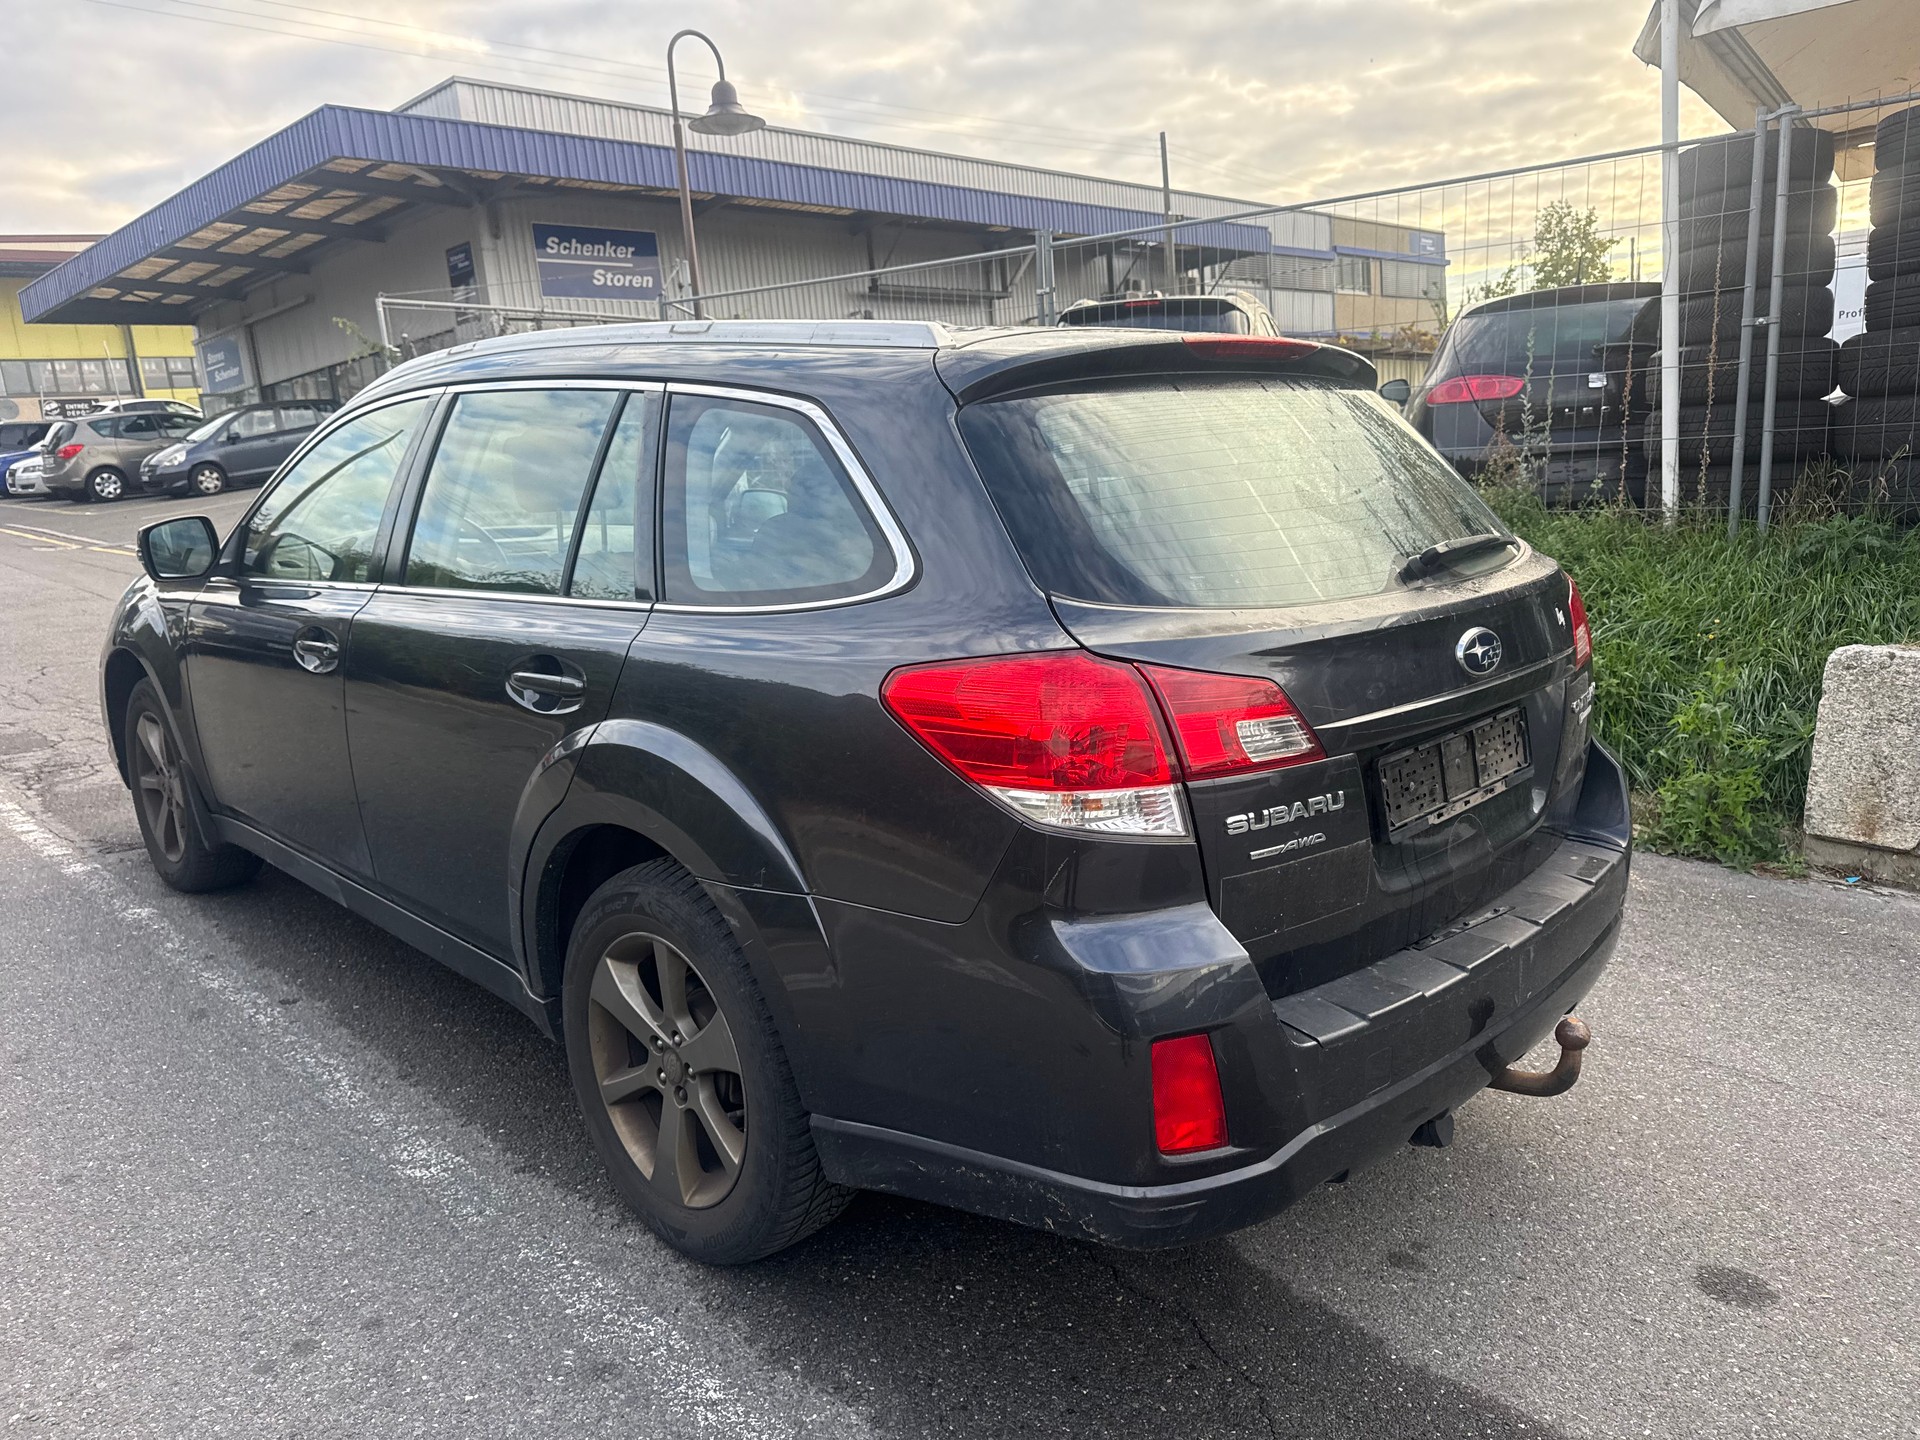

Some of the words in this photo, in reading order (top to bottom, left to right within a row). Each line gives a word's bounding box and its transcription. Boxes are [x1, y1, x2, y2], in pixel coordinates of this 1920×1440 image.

[546, 236, 635, 258] Schenker
[592, 269, 653, 288] Storen
[1838, 307, 1864, 319] Prof
[1226, 790, 1344, 836] SUBARU
[1281, 832, 1327, 854] AWD
